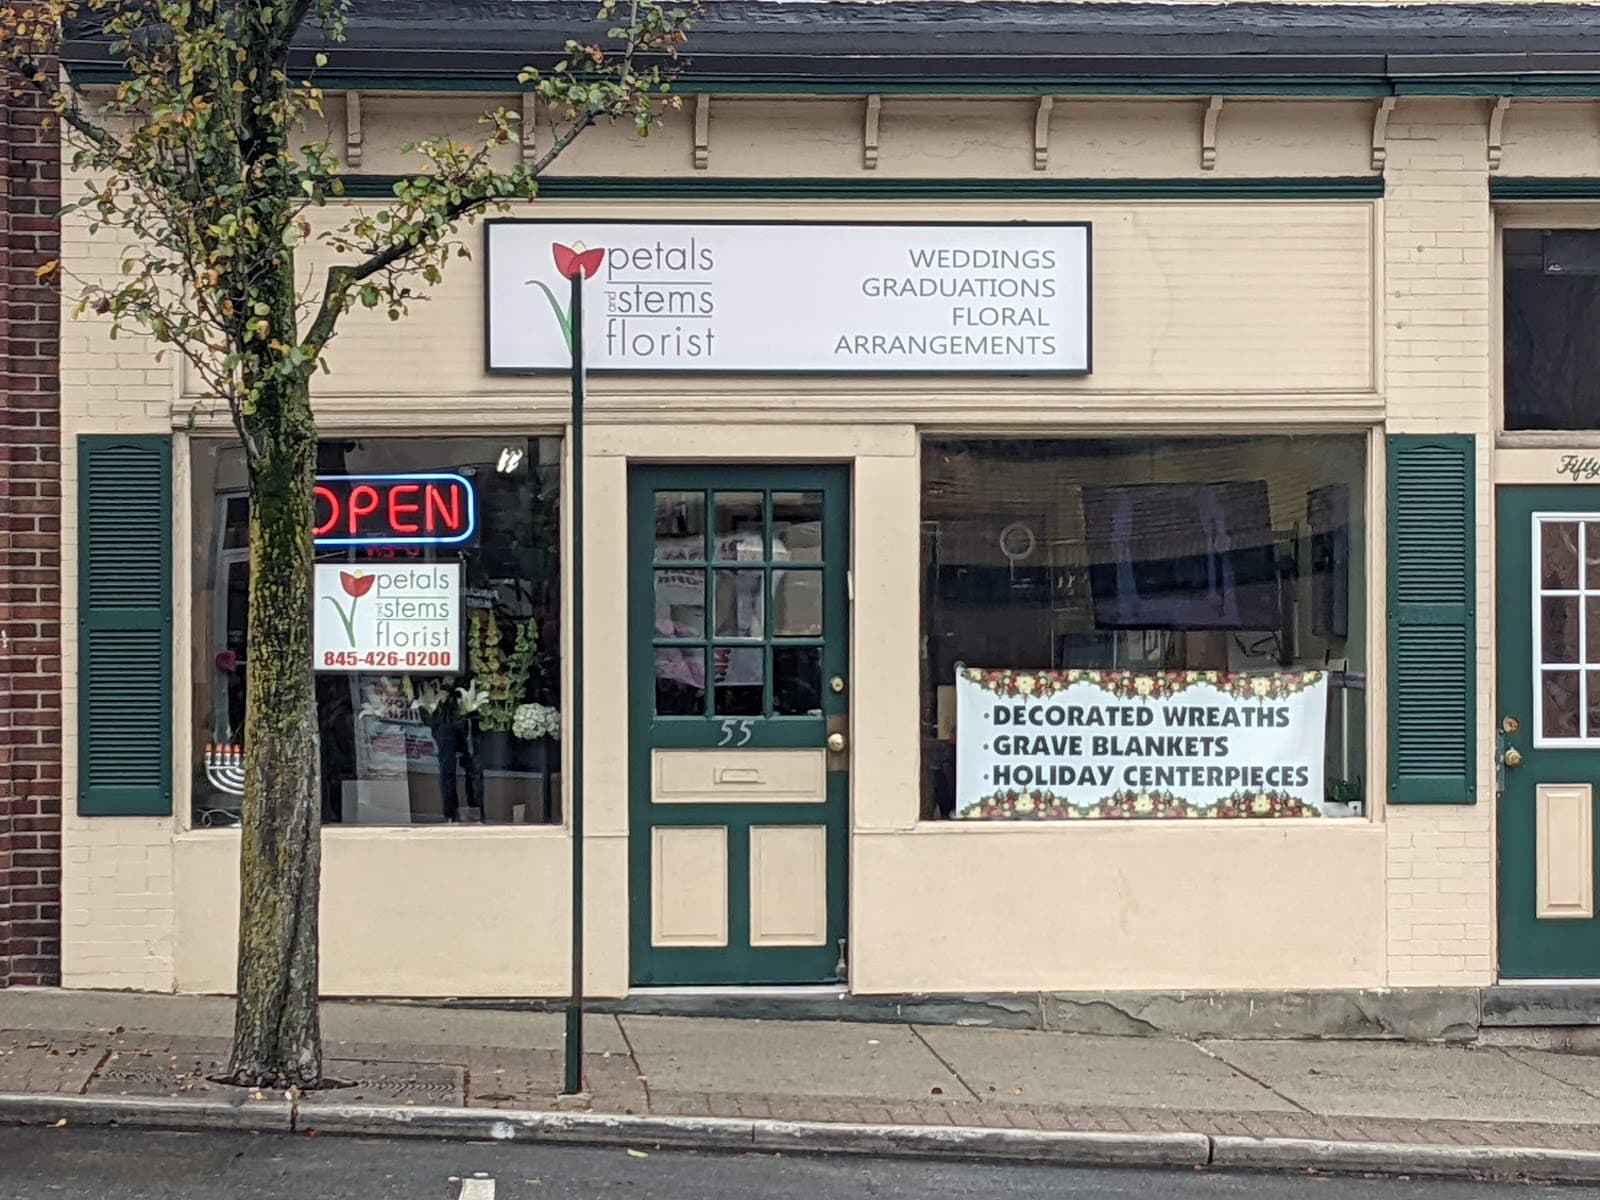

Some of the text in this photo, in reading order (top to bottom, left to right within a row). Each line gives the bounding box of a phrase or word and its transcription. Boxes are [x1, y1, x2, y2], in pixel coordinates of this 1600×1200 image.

[608, 236, 714, 281] petals
[909, 249, 1056, 269] WEDDINGS
[618, 284, 714, 314] stems
[862, 278, 1056, 298] GRADUATIONS
[952, 306, 1050, 326] FLORAL
[606, 318, 716, 357] florist
[834, 335, 1056, 355] ARRANGEMENTS
[311, 484, 459, 536] OPEN
[377, 567, 450, 597] petals
[384, 598, 449, 618] stems
[376, 621, 450, 647] florist
[324, 651, 451, 667] 845-426-0200
[992, 704, 1290, 729] DECORATED WREATHS
[718, 720, 755, 747] 55
[992, 735, 1229, 758] GRAVE BLANKETS
[992, 764, 1310, 788] HOLIDAY CENTERPIECES
